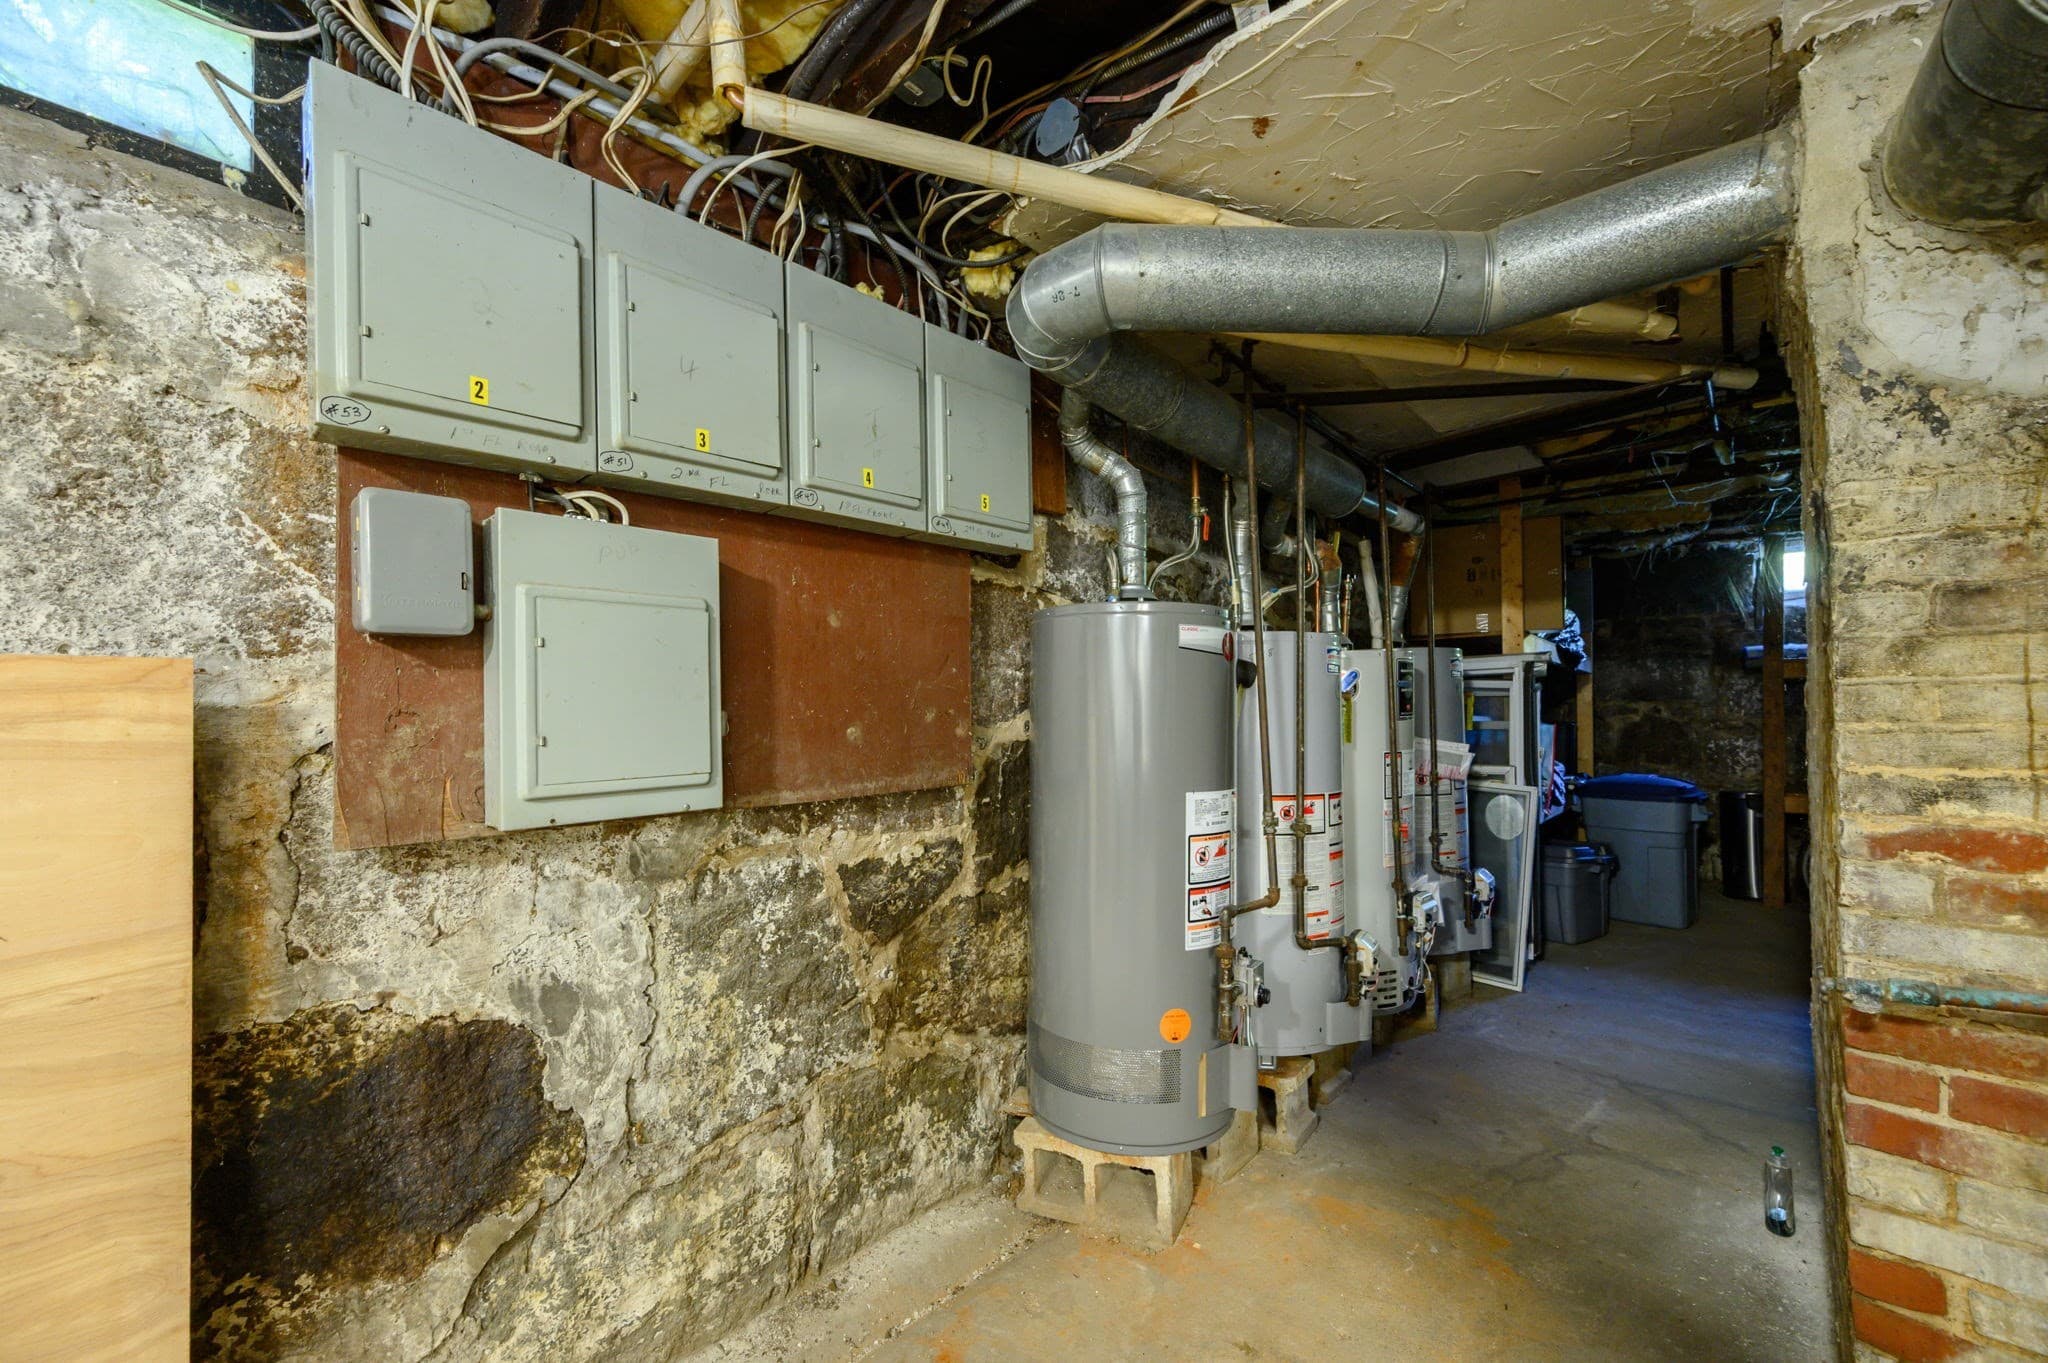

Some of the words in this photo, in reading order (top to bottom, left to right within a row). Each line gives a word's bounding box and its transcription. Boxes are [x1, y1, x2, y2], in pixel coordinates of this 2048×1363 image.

[475, 381, 484, 399] 2
[325, 403, 361, 417] #53
[699, 432, 706, 448] 3
[603, 455, 627, 467] #51
[709, 476, 728, 489] FL
